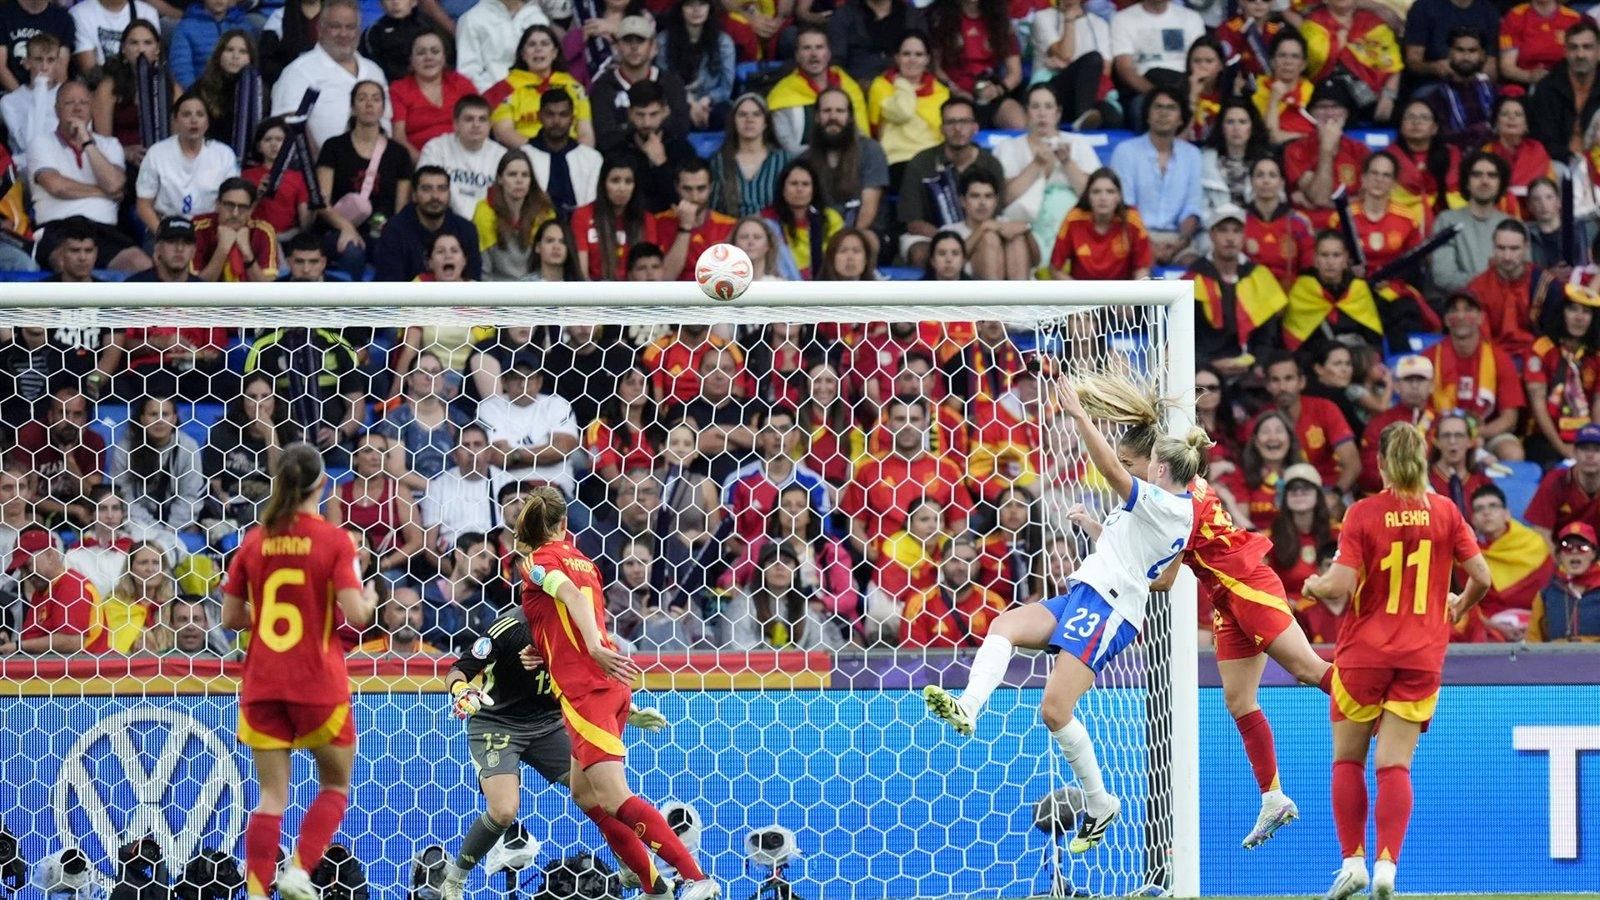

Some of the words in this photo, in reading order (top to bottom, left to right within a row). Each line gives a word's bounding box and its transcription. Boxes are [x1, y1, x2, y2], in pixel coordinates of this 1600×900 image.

[181, 194, 193, 215] 8
[1385, 510, 1430, 528] ALEXIA
[261, 536, 312, 557] AITANA
[1380, 539, 1432, 615] 11
[258, 568, 306, 653] 6
[1064, 607, 1101, 638] 23
[1512, 725, 1600, 859] T
